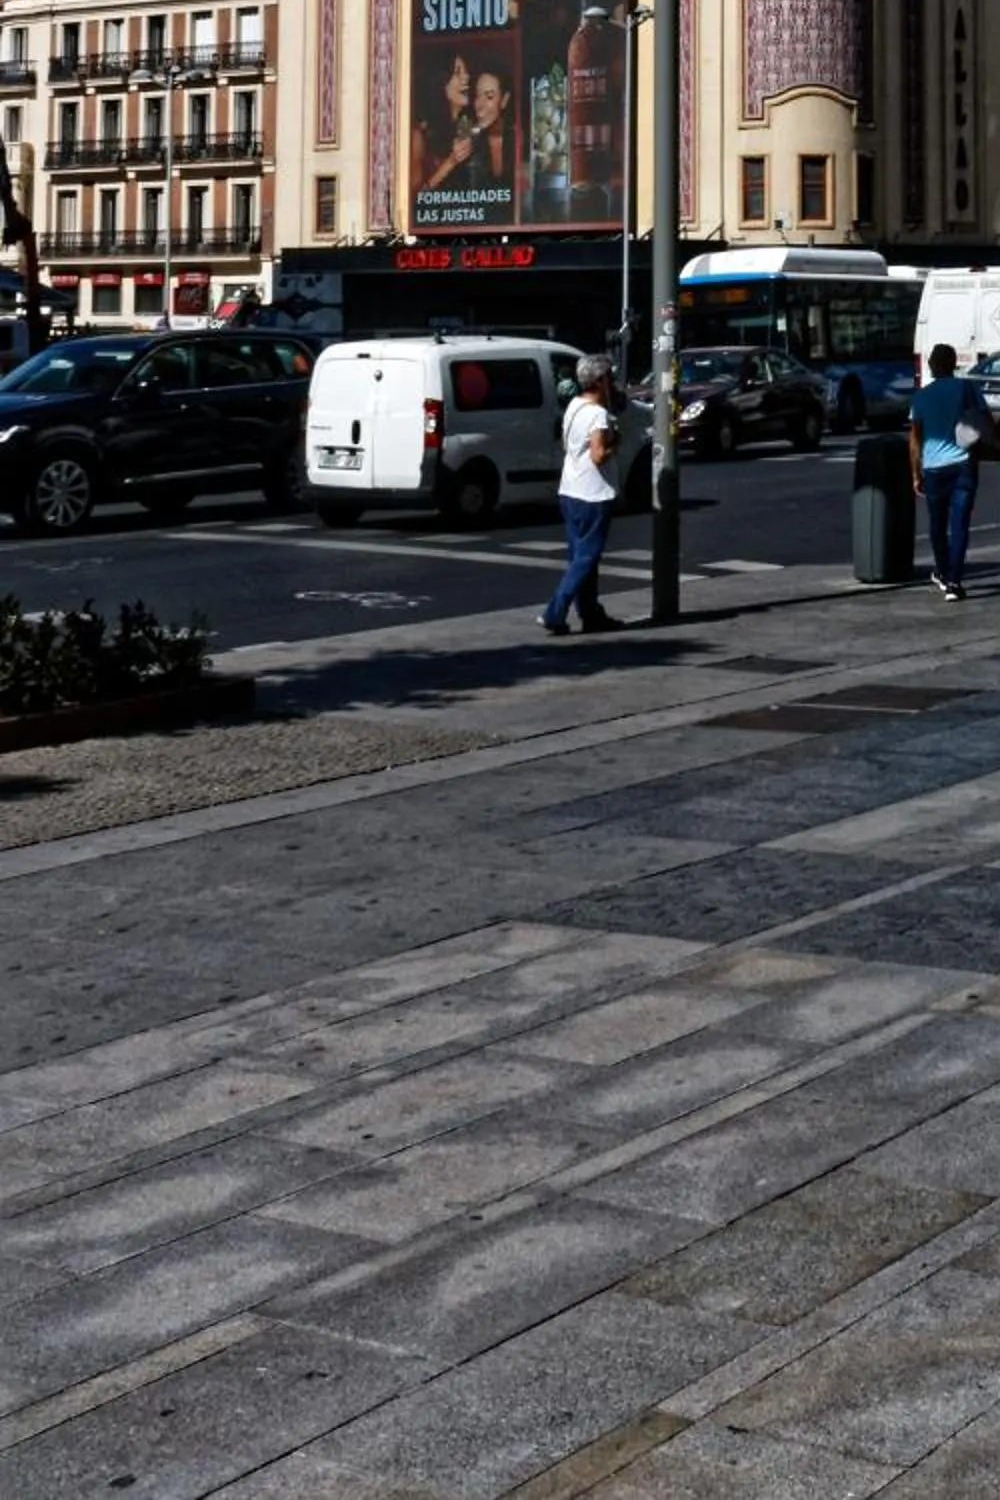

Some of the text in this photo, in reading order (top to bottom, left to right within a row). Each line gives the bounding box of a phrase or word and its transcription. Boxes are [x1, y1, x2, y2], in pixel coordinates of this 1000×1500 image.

[417, 189, 511, 205] FORMALIDADES
[417, 208, 485, 222] LAS JUSTAS
